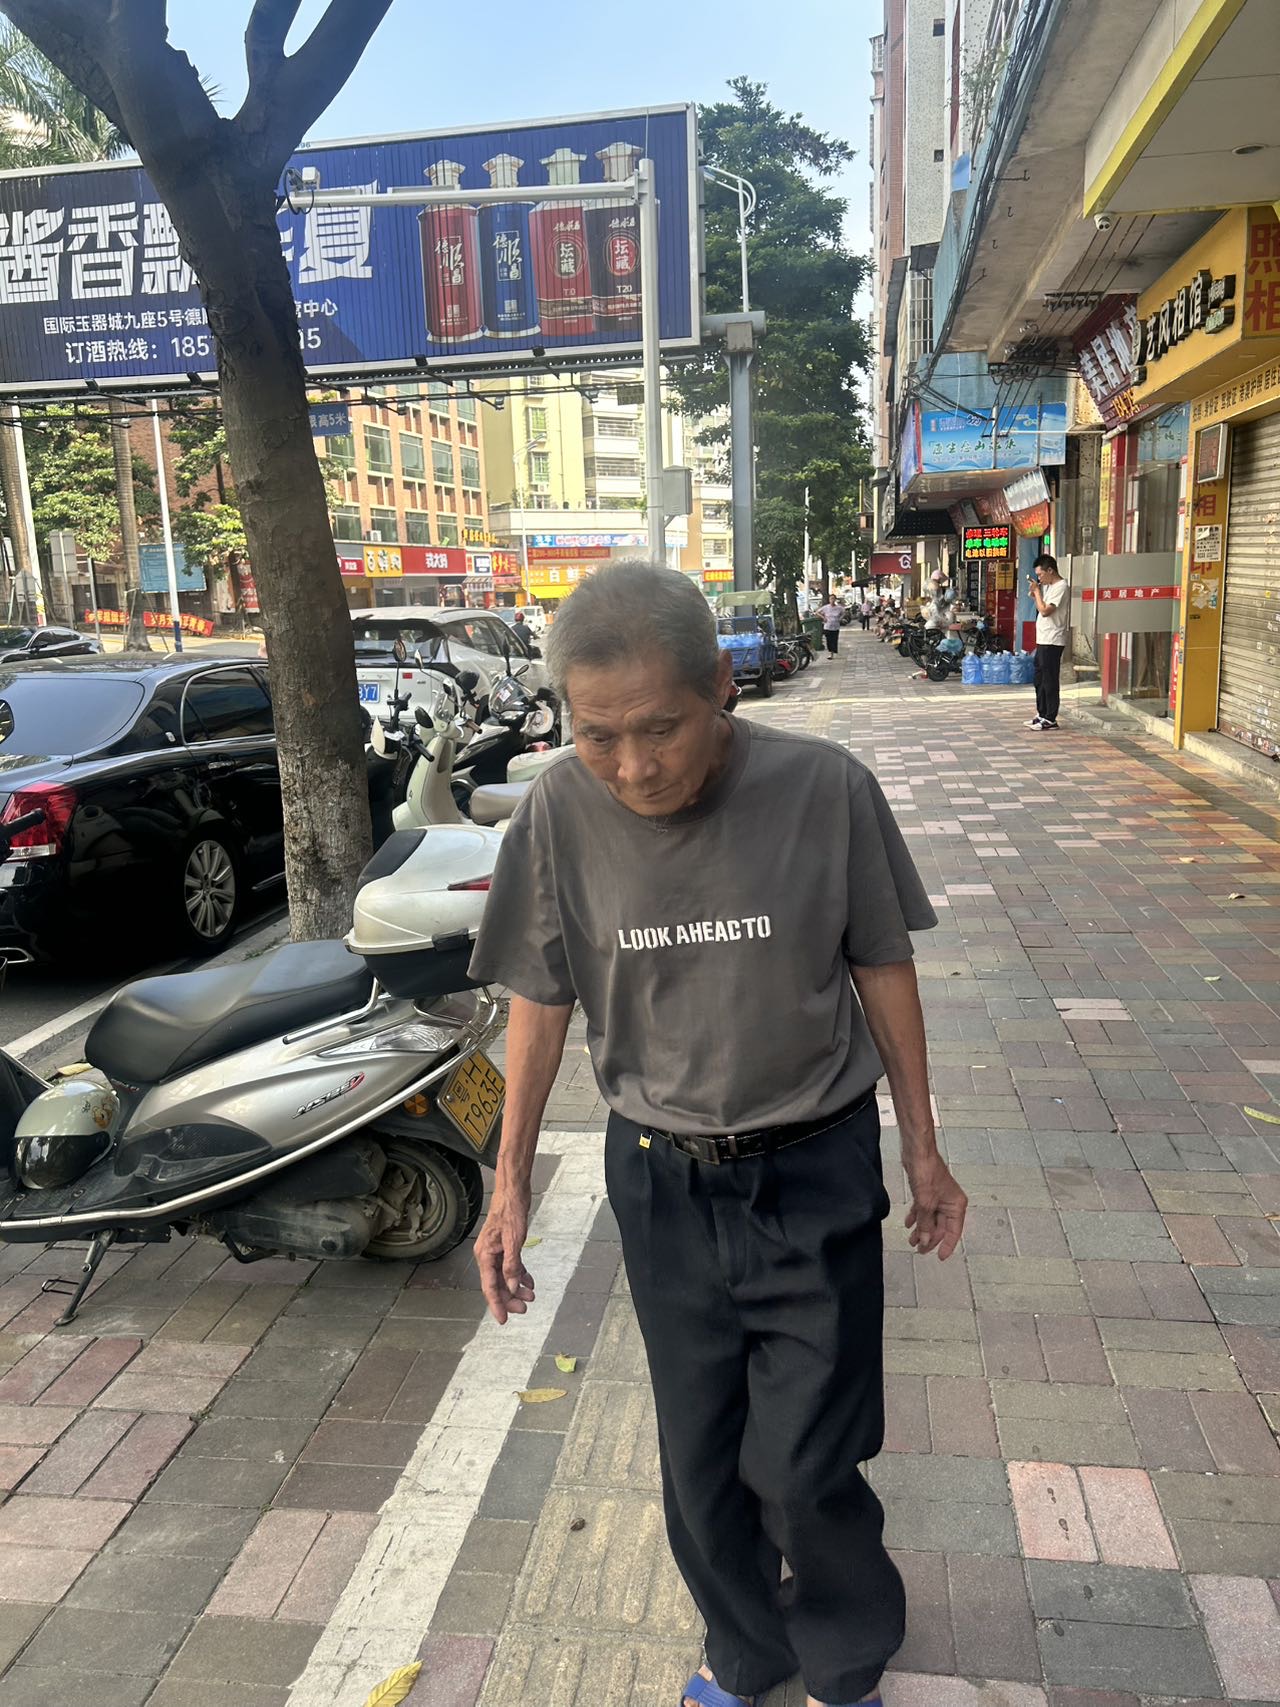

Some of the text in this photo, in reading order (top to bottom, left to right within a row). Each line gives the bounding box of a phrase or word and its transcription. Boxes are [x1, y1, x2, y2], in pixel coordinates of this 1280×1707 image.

[617, 285, 632, 294] T20
[43, 298, 338, 335] 国际玉器城九座5号德中心
[1146, 268, 1203, 361] 艺风相馆
[1103, 588, 1160, 598] 美居地产
[618, 926, 673, 951] LOOK
[741, 915, 772, 940] TO
[464, 1068, 505, 1138] T963E
